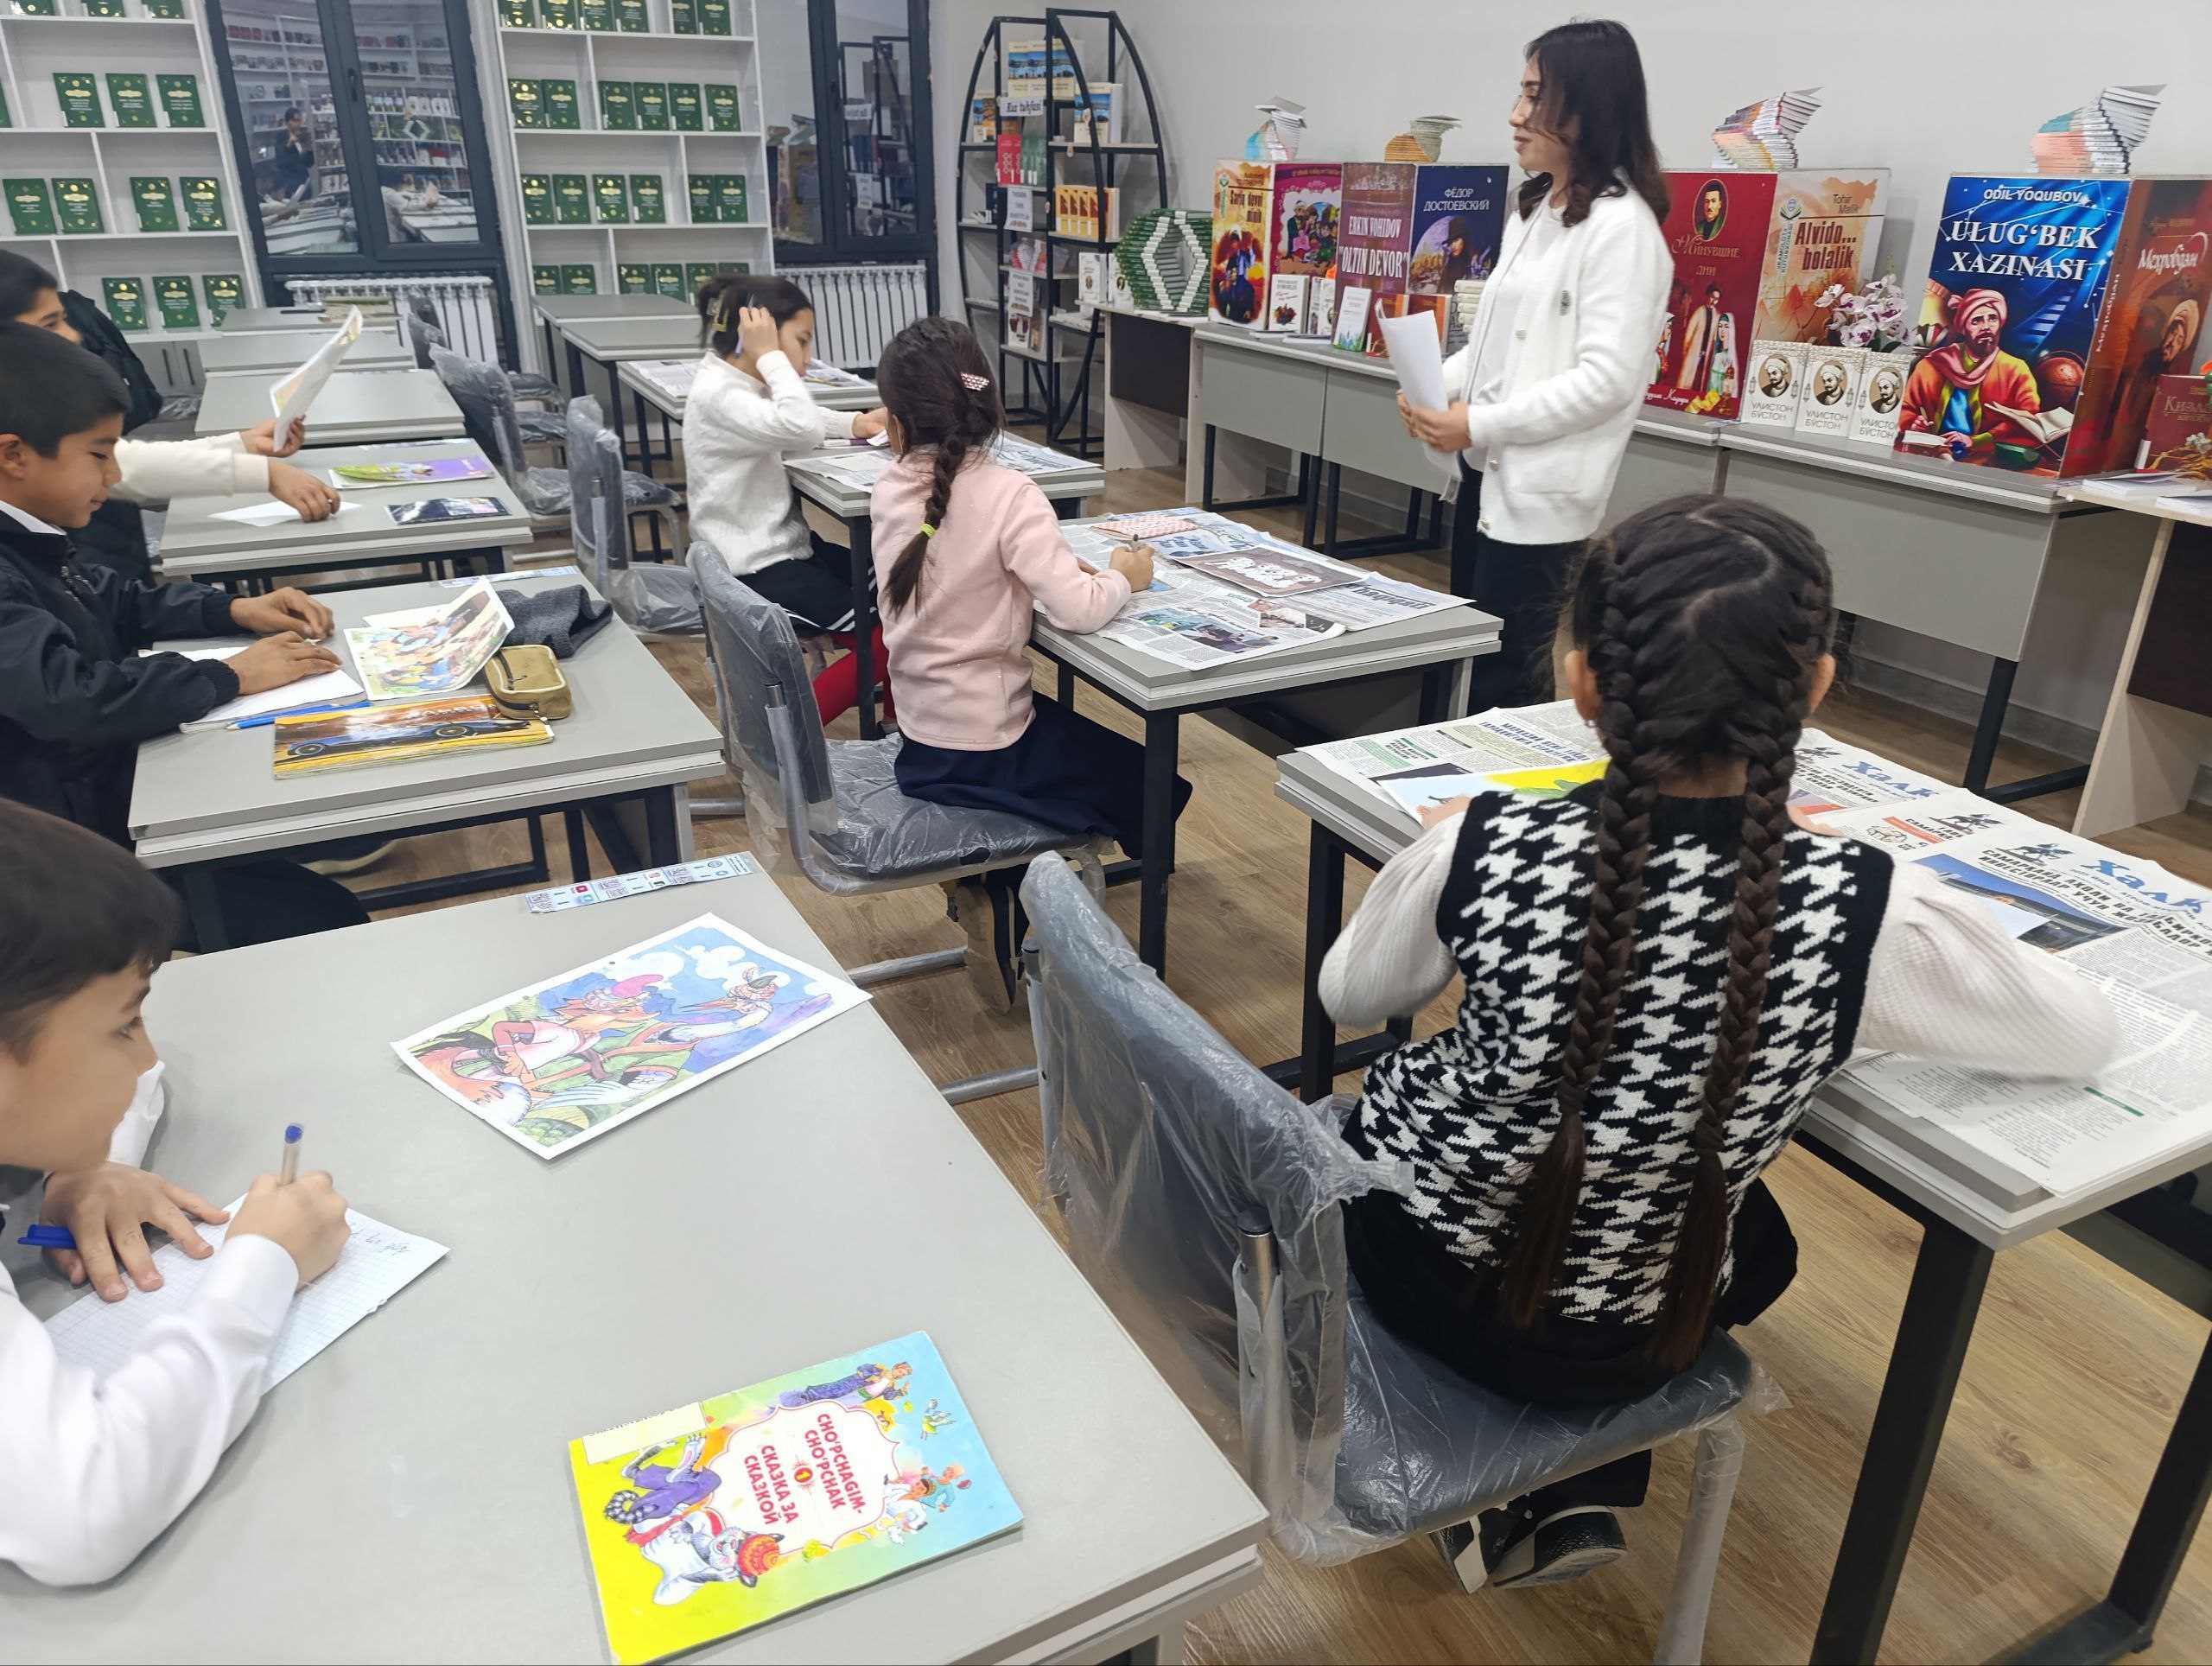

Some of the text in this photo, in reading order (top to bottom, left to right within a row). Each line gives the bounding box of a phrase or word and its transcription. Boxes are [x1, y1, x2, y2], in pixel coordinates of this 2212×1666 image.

[1444, 186, 1474, 199] ФЁДОР
[1983, 188, 2083, 203] ODIL YOQUBOV
[1423, 199, 1490, 212] ДОСТОЕВСКИЙ
[1348, 215, 1402, 238] ERKIN VOHIDOV
[1802, 245, 1854, 270] bolalik
[1948, 251, 2088, 281] XAZINASI
[2072, 891, 2111, 910] УЧУН
[743, 1454, 783, 1525] СКАЗКОЙ
[760, 1445, 799, 1523] СКАЗКА ЗА
